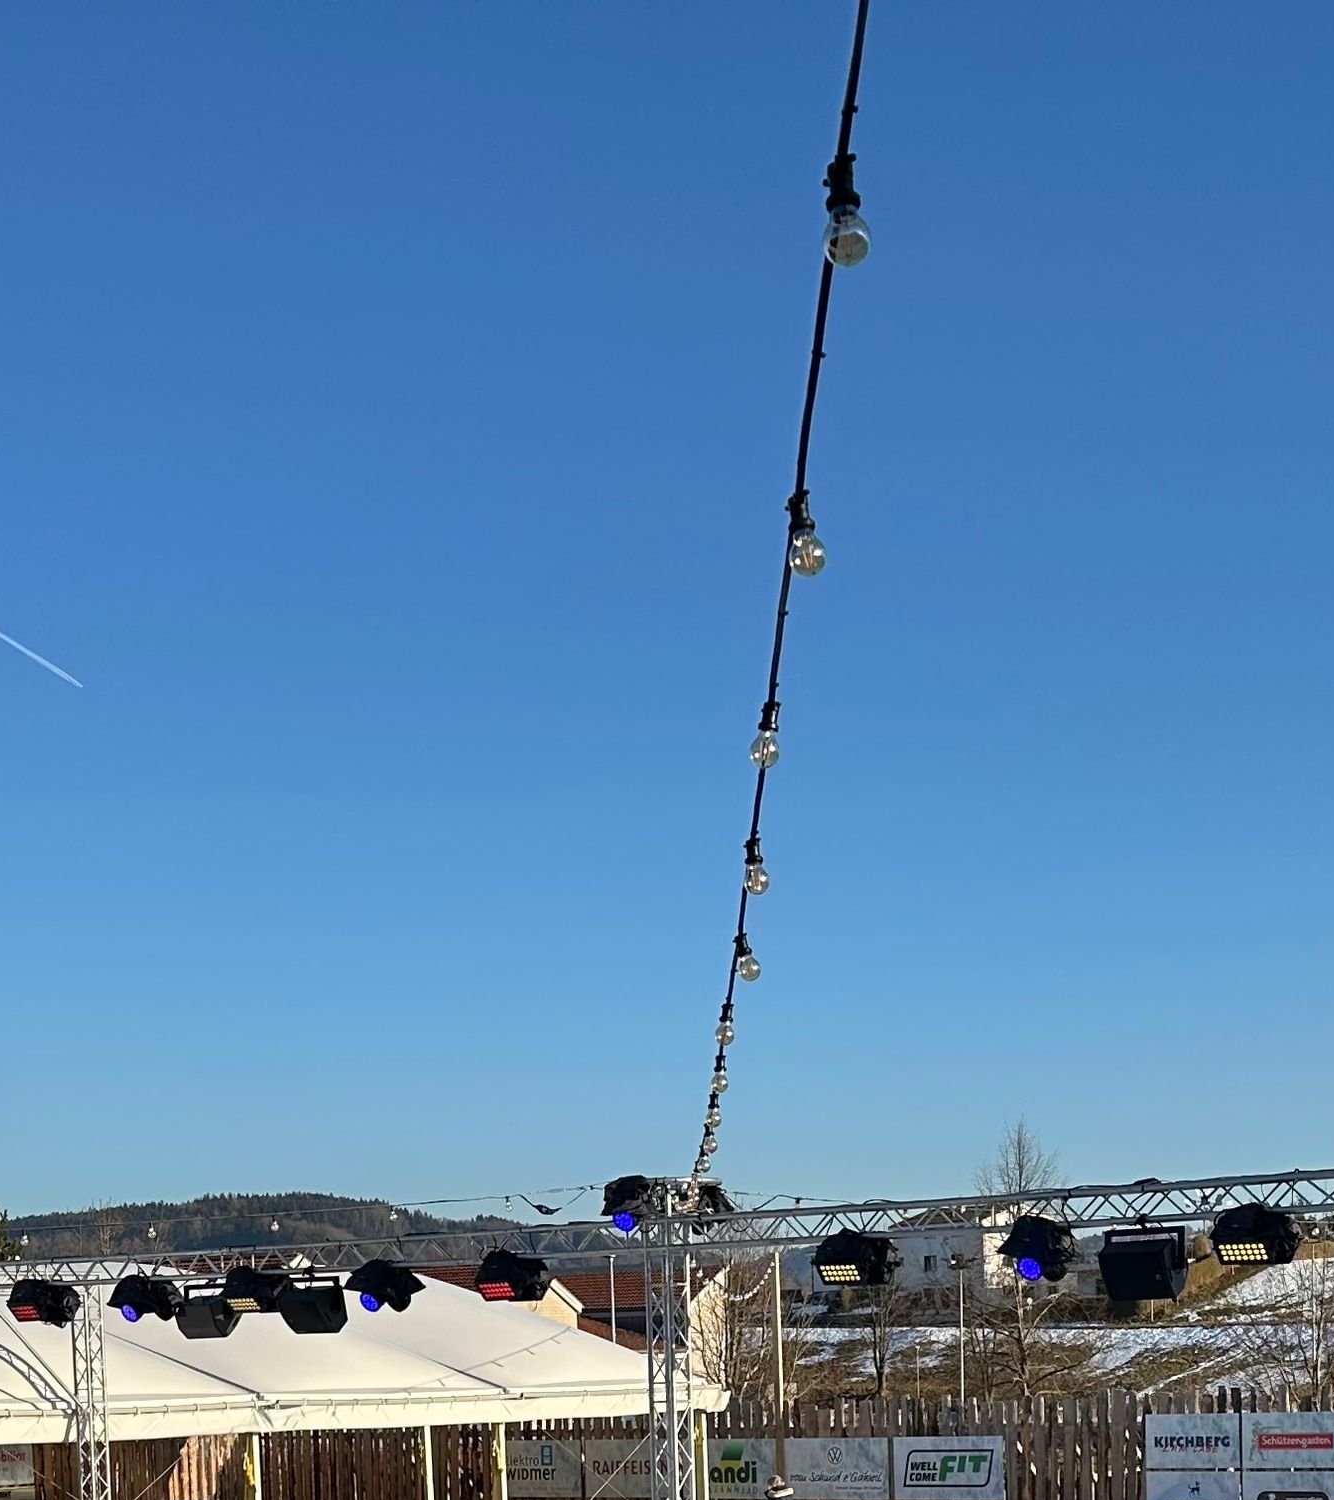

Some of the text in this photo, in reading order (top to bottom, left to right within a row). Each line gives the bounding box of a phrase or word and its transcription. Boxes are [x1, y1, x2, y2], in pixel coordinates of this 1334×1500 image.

[1261, 1435, 1331, 1448] Schützengarten
[592, 1460, 668, 1476] RAIFFEISN
[709, 1461, 757, 1484] andi
[910, 1461, 938, 1471] WELL
[939, 1455, 988, 1482] FIT
[909, 1472, 938, 1482] COME
